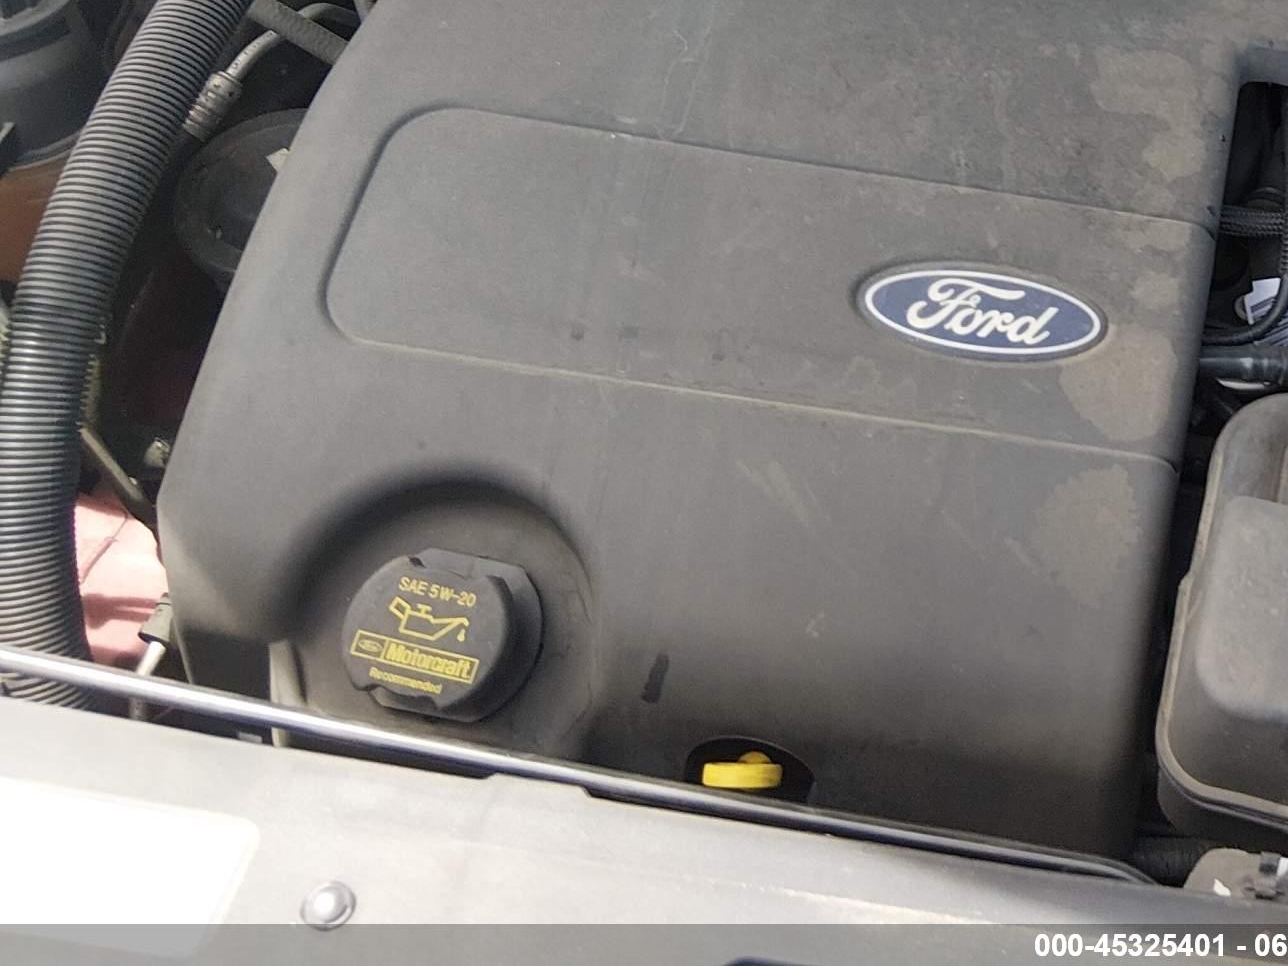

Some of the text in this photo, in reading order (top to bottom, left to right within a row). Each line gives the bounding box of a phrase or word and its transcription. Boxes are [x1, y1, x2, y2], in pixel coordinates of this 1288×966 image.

[906, 278, 1059, 345] Ford
[398, 577, 477, 607] SAE 5W-20
[386, 643, 471, 678] Motorcraft
[368, 666, 443, 694] Recommended
